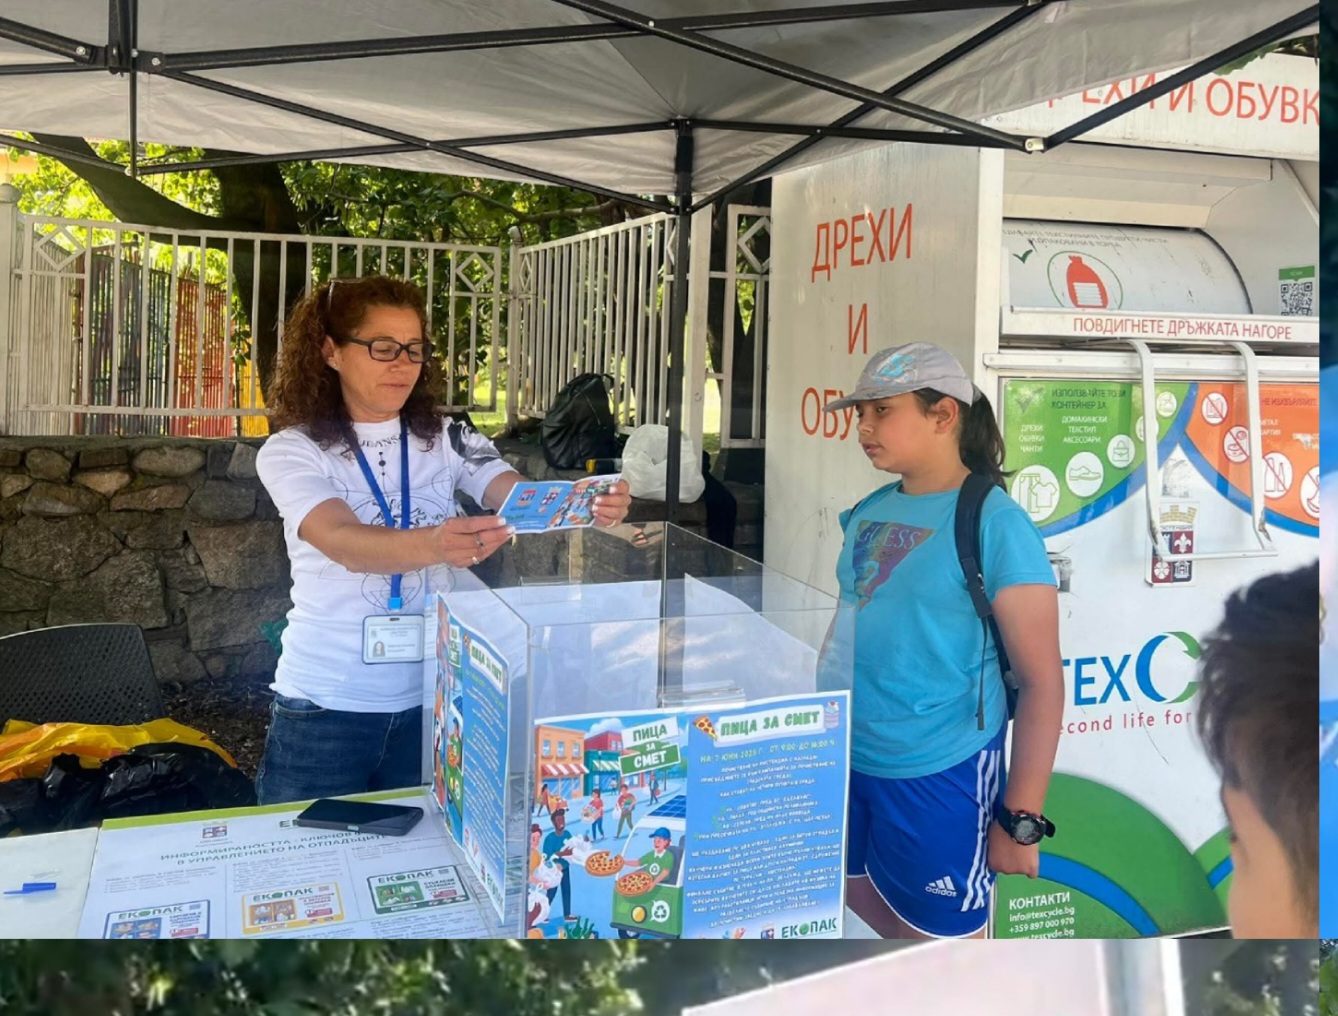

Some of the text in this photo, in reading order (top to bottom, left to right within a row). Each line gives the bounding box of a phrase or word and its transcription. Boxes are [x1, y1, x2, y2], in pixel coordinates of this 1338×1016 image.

[811, 203, 913, 283] ДРЕХИ
[848, 303, 868, 355] И
[1073, 317, 1292, 340] ПОВДИГНЕТЕ ДРЪЖКАТА НАГОРЕ
[801, 387, 857, 441] ОБУ
[857, 525, 922, 550] GUESS
[720, 711, 820, 736] ПИЦА ЗА СМЕТ
[1123, 712, 1155, 729] life
[1165, 709, 1192, 725] for
[633, 724, 668, 742] ПИЦА
[645, 743, 656, 751] ЗА
[633, 750, 667, 768] СМЕТ
[160, 840, 291, 860] ИНФОРМИРАНОСТТА
[188, 845, 285, 864] УПРАВЛЕНИЕТО
[925, 886, 957, 897] adidas
[1009, 891, 1070, 910] КОНТАКТИ
[1010, 906, 1075, 922] info@texcycle.bg
[781, 917, 838, 938] ЕКОПАК
[1009, 917, 1074, 933] +359 897 000 970
